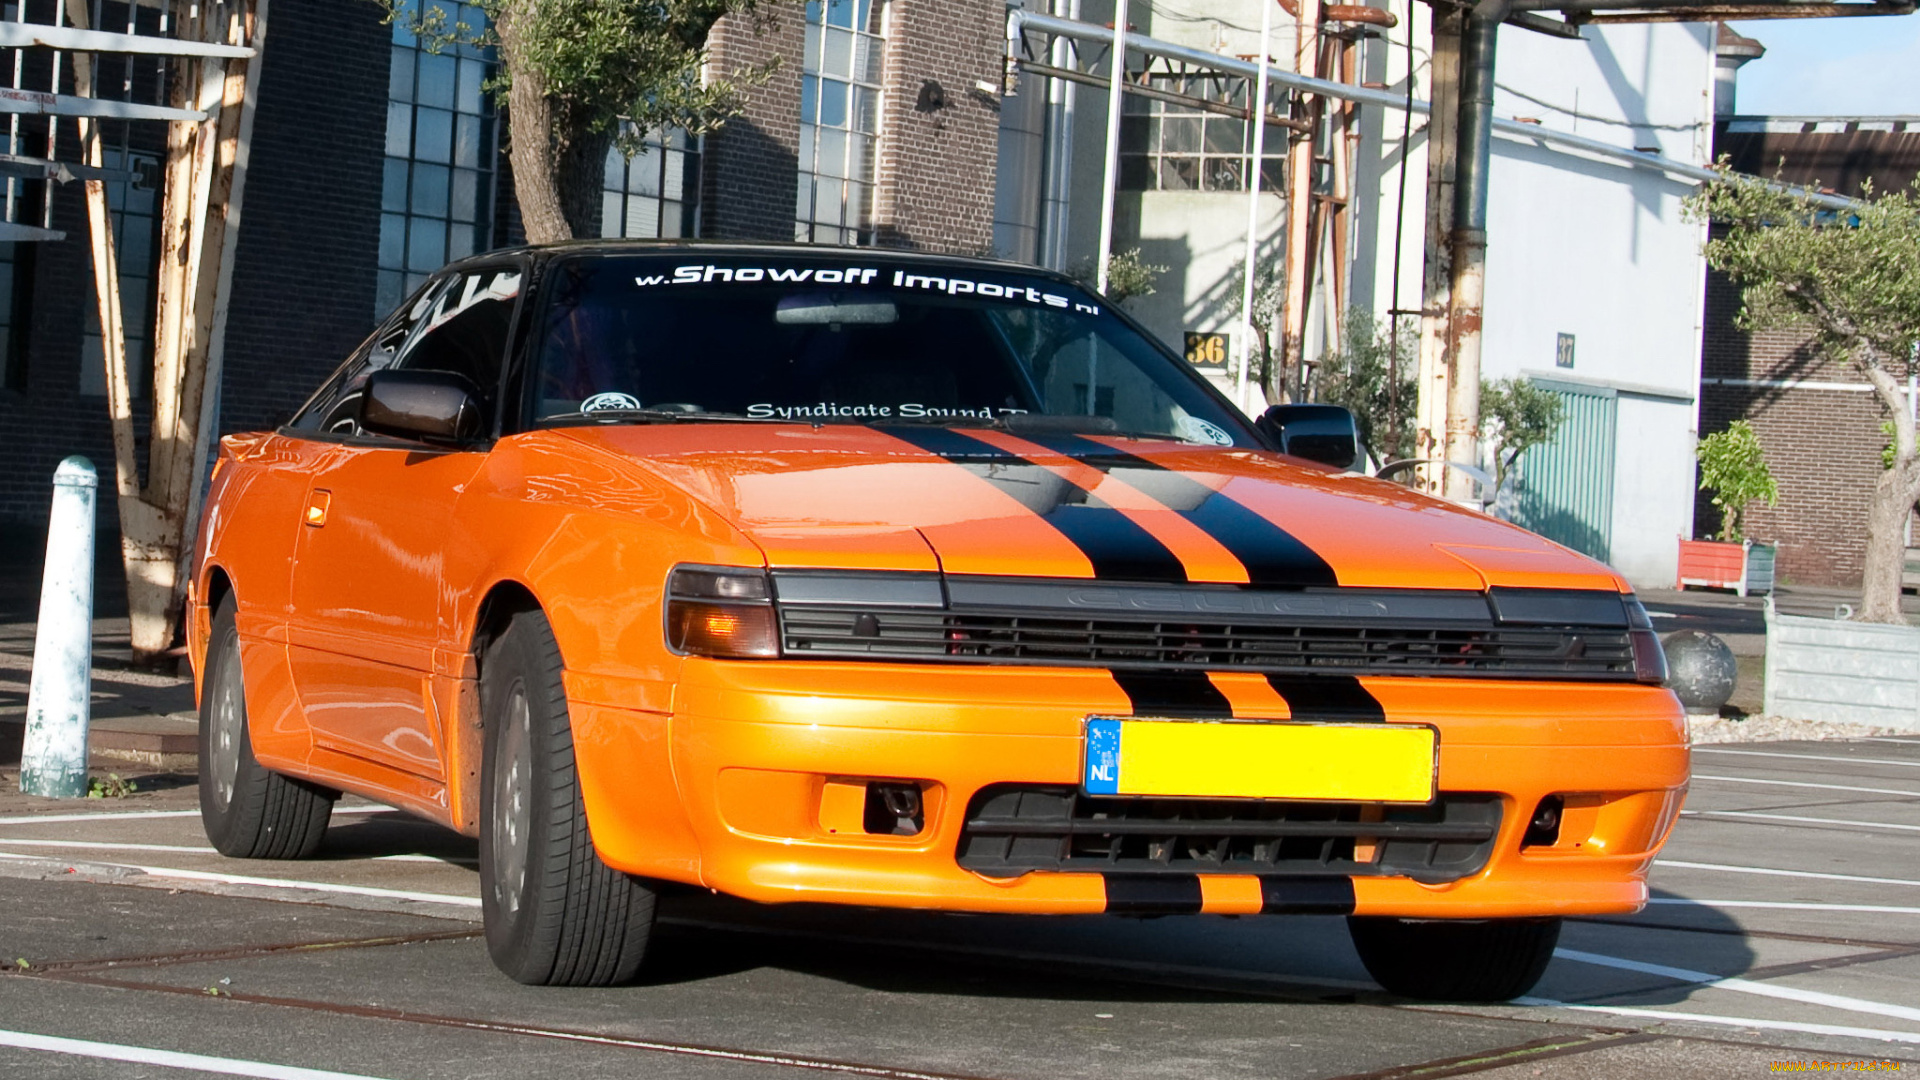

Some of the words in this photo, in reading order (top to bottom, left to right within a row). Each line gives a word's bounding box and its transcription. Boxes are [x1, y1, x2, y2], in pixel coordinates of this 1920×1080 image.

[893, 270, 1069, 309] Imports
[1187, 335, 1225, 364] 36
[1558, 336, 1573, 364] 37
[746, 402, 892, 420] Syndicate
[899, 403, 994, 420] Sound
[1091, 764, 1114, 781] NL
